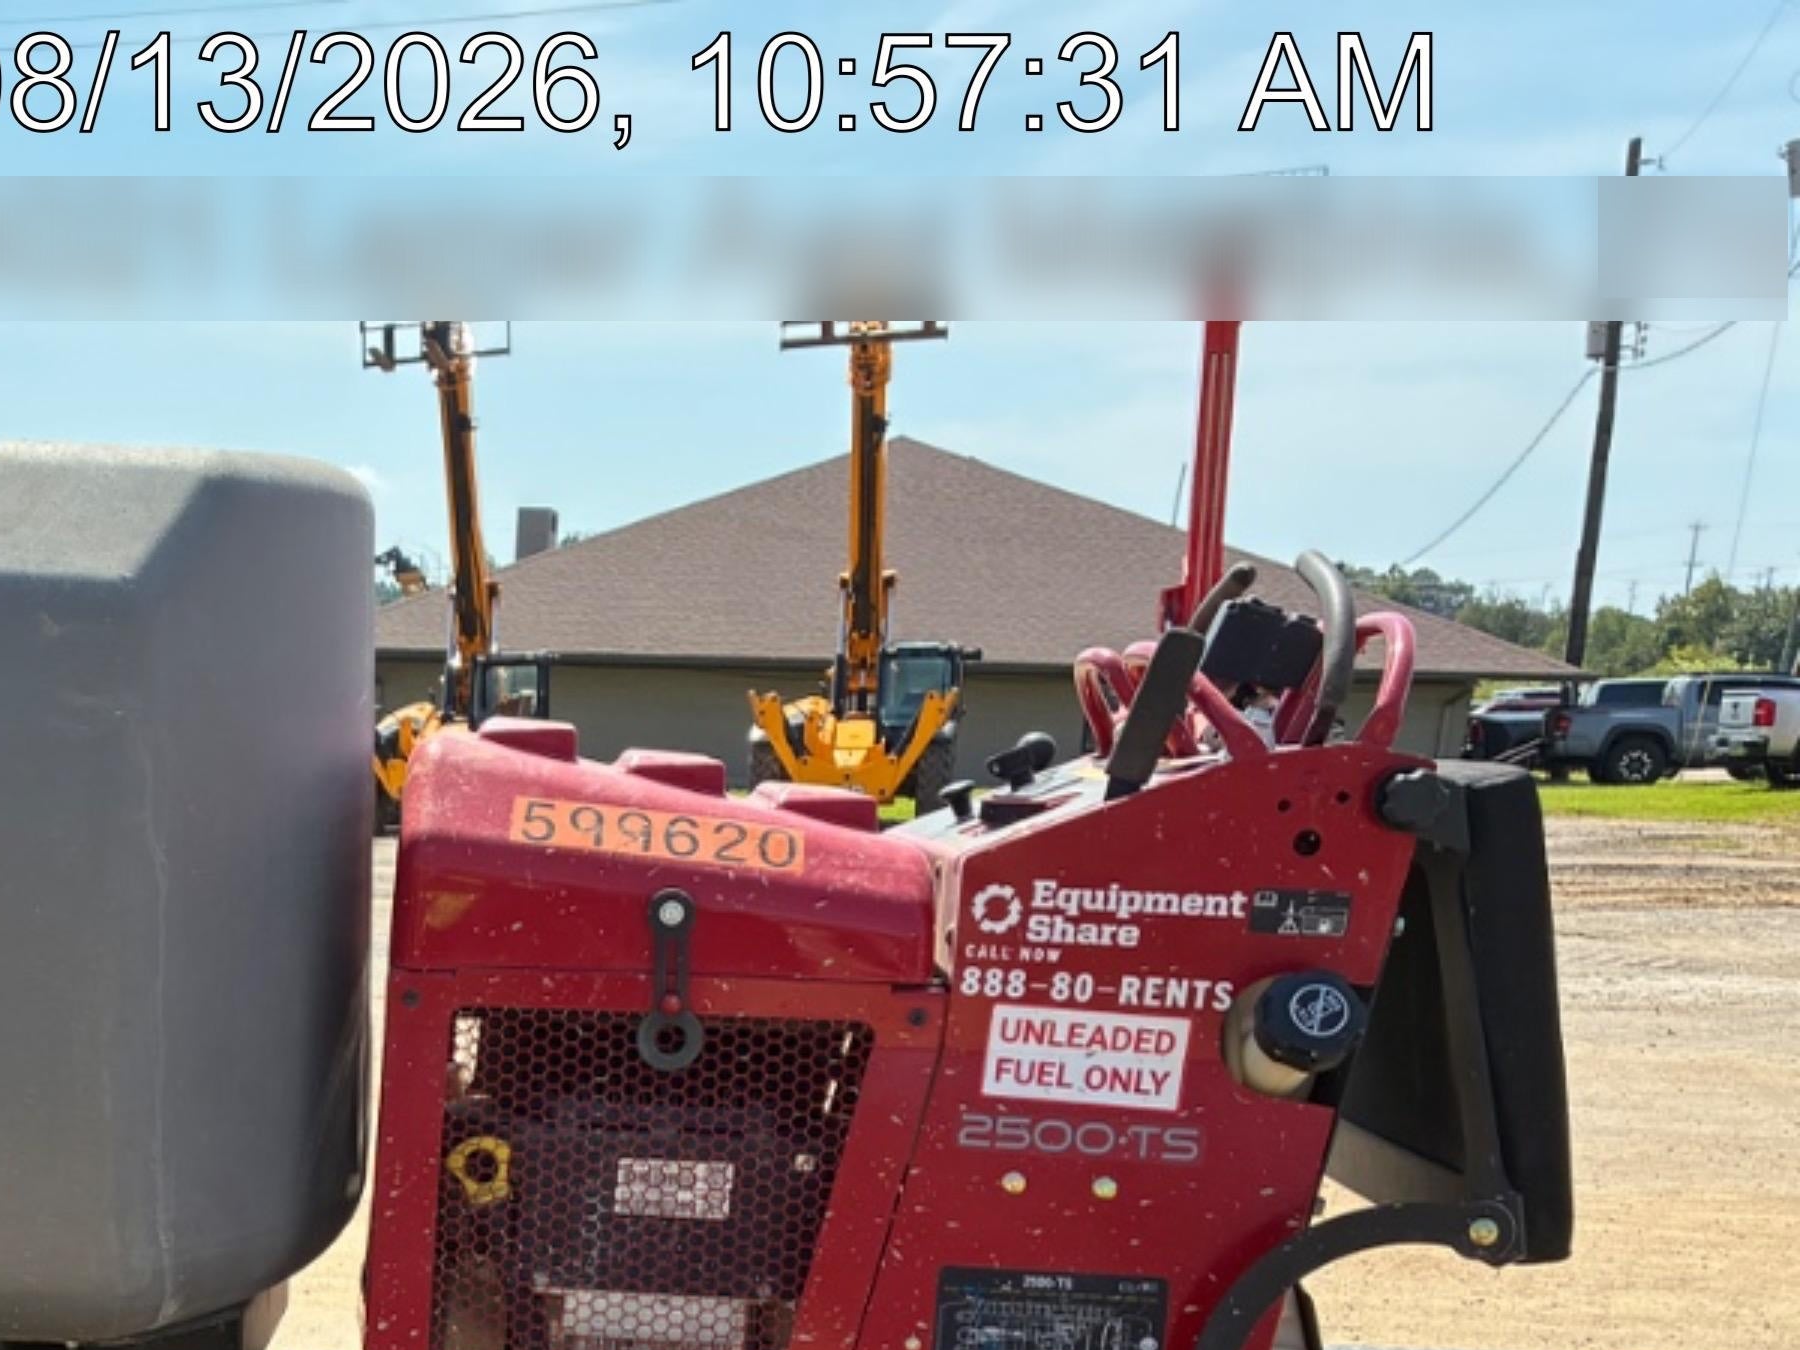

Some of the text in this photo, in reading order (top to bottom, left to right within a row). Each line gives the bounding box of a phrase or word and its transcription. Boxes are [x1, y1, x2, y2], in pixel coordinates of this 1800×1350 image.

[521, 800, 798, 868] 599620
[1031, 878, 1248, 919] Equipment
[1025, 914, 1141, 947] Share
[964, 943, 1062, 963] CALL NOW
[959, 966, 1234, 1012] 888-80-RENTS
[999, 1018, 1177, 1056] UNLEADED
[993, 1057, 1171, 1097] FUEL ONLY
